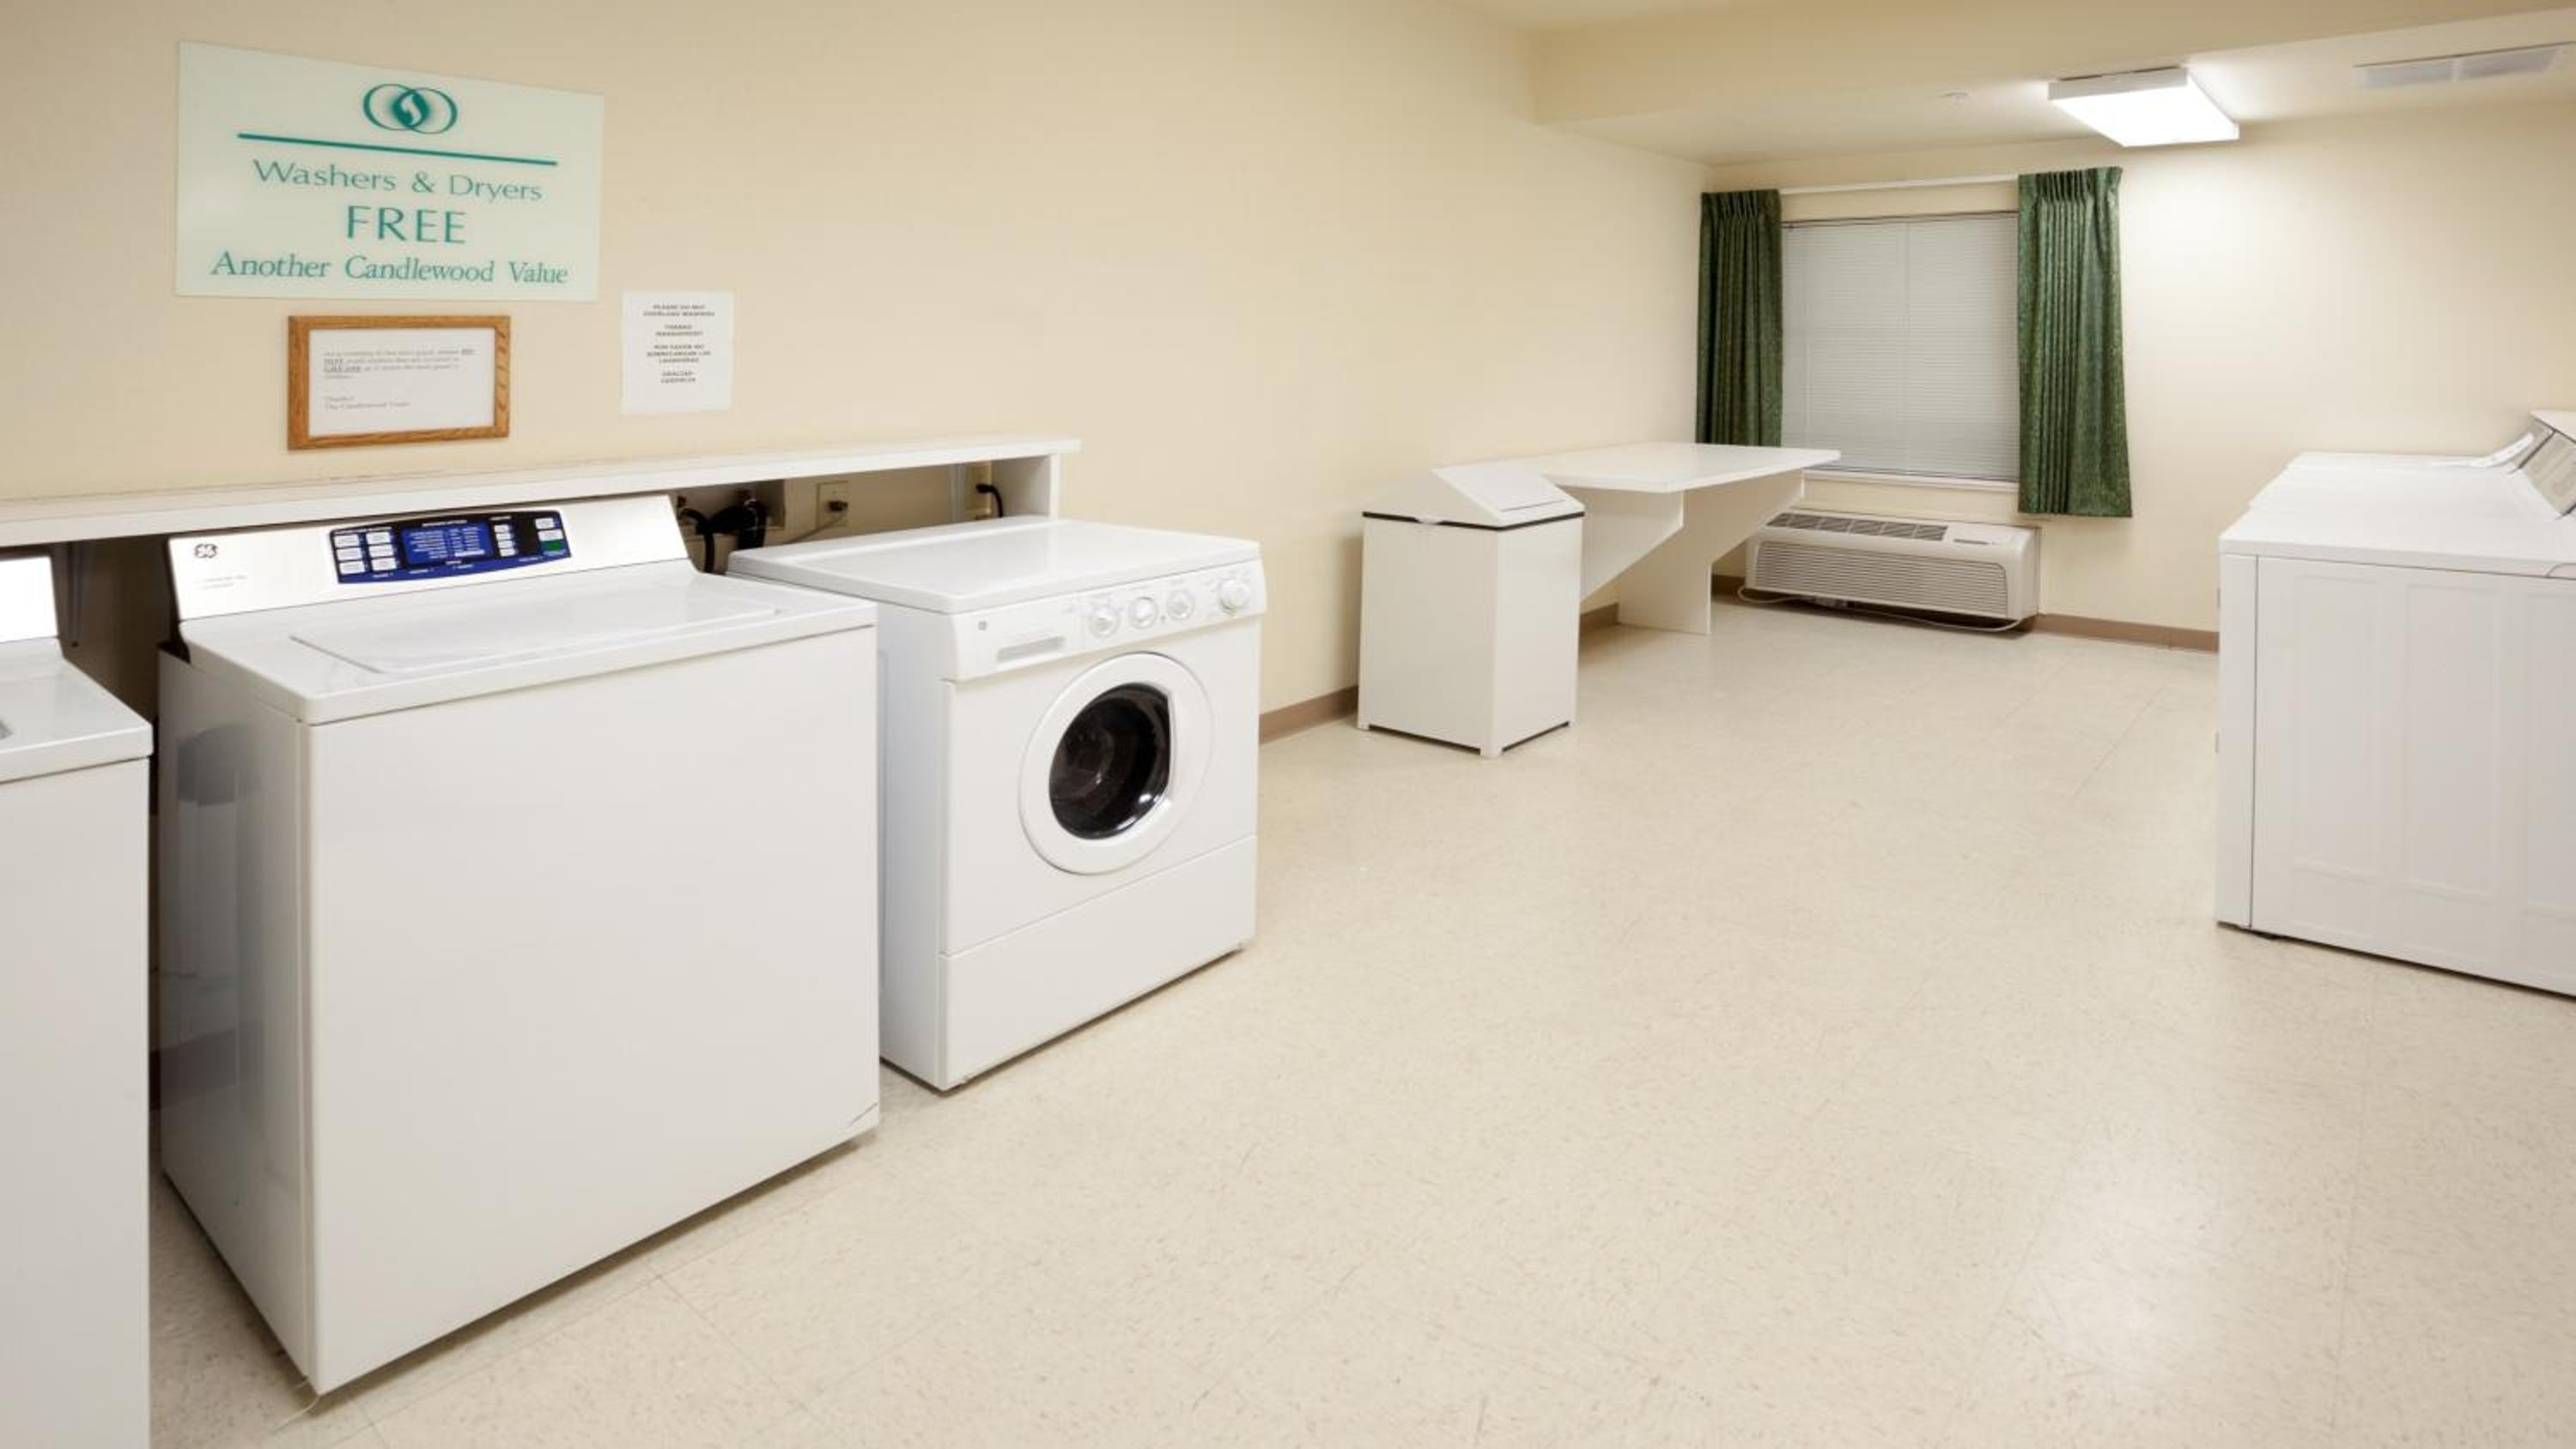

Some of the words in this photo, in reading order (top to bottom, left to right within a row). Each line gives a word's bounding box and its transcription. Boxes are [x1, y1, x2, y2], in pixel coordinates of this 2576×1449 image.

[252, 159, 397, 191] Washers
[411, 171, 436, 194] &
[449, 173, 543, 203] Dryers
[346, 205, 466, 245] FREE
[210, 250, 331, 279] Another
[343, 254, 495, 283] Candlewood
[508, 260, 568, 285] Value
